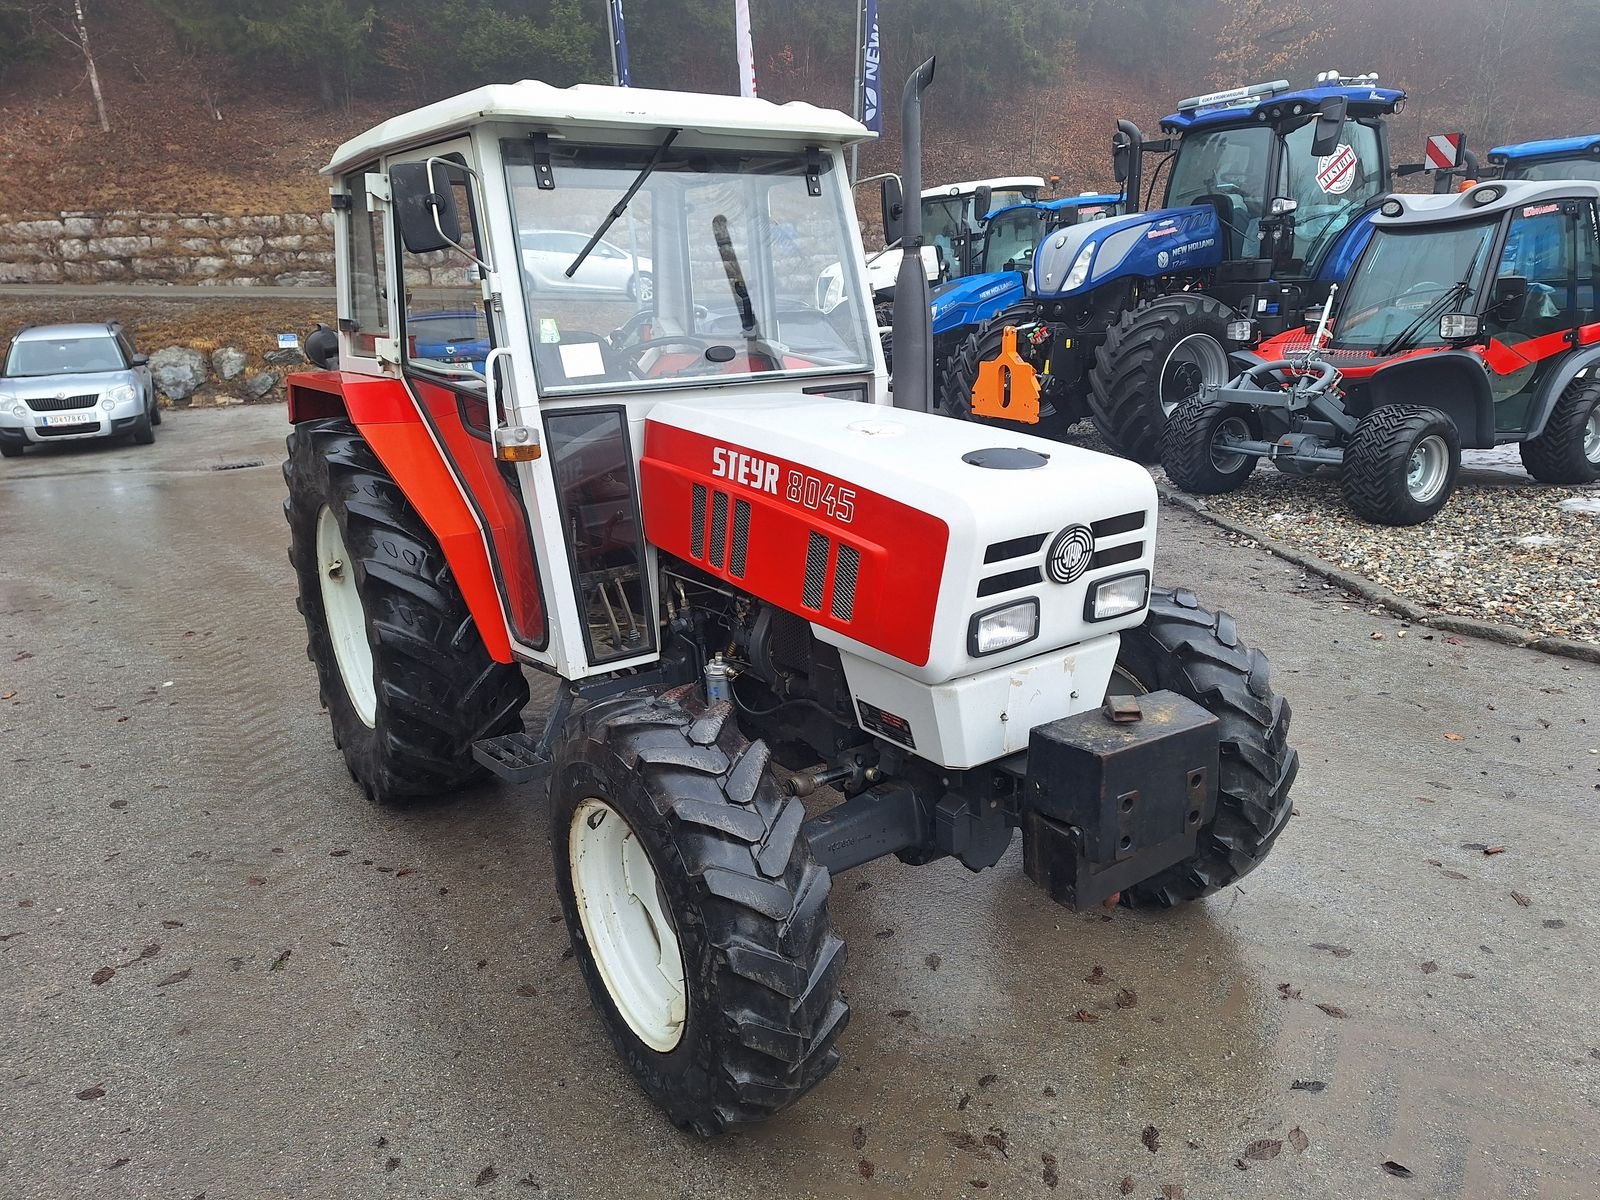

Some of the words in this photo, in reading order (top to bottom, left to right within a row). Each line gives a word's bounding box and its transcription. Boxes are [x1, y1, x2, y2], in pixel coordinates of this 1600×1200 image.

[1172, 245, 1187, 257] NEW
[1187, 238, 1215, 252] HOLLAND
[979, 289, 991, 299] NEW
[991, 281, 1014, 295] HOLLAND
[712, 446, 780, 496] STEYR
[786, 470, 856, 523] 8045
